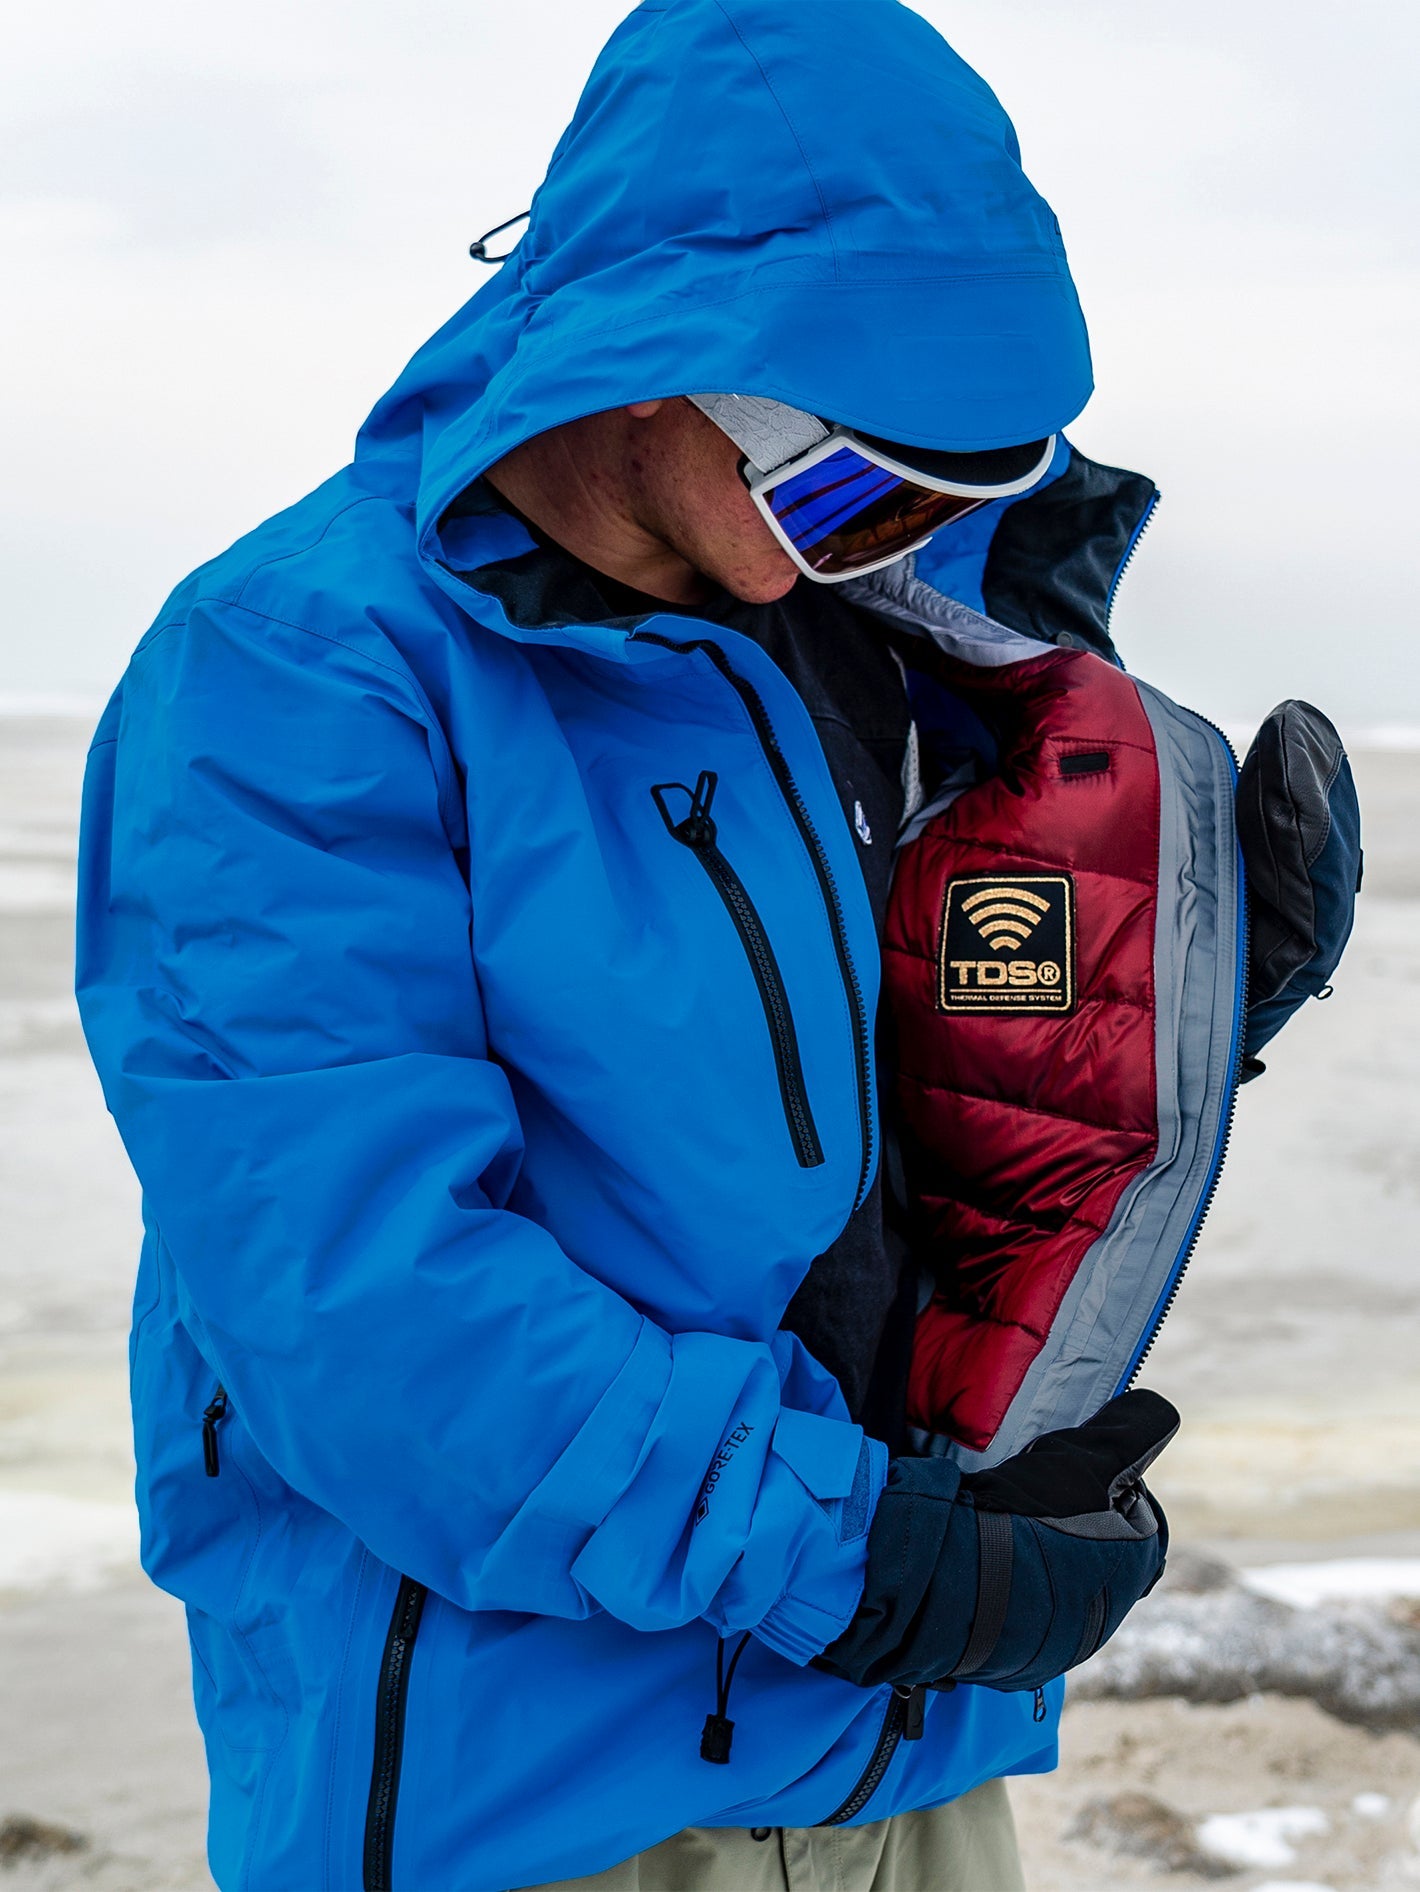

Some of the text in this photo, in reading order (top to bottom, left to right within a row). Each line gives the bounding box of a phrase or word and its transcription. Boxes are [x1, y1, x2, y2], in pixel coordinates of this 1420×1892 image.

[950, 994, 1062, 1002] THERMAL DEFENSE SYSTEM
[704, 1421, 755, 1494] GORE-TEX
